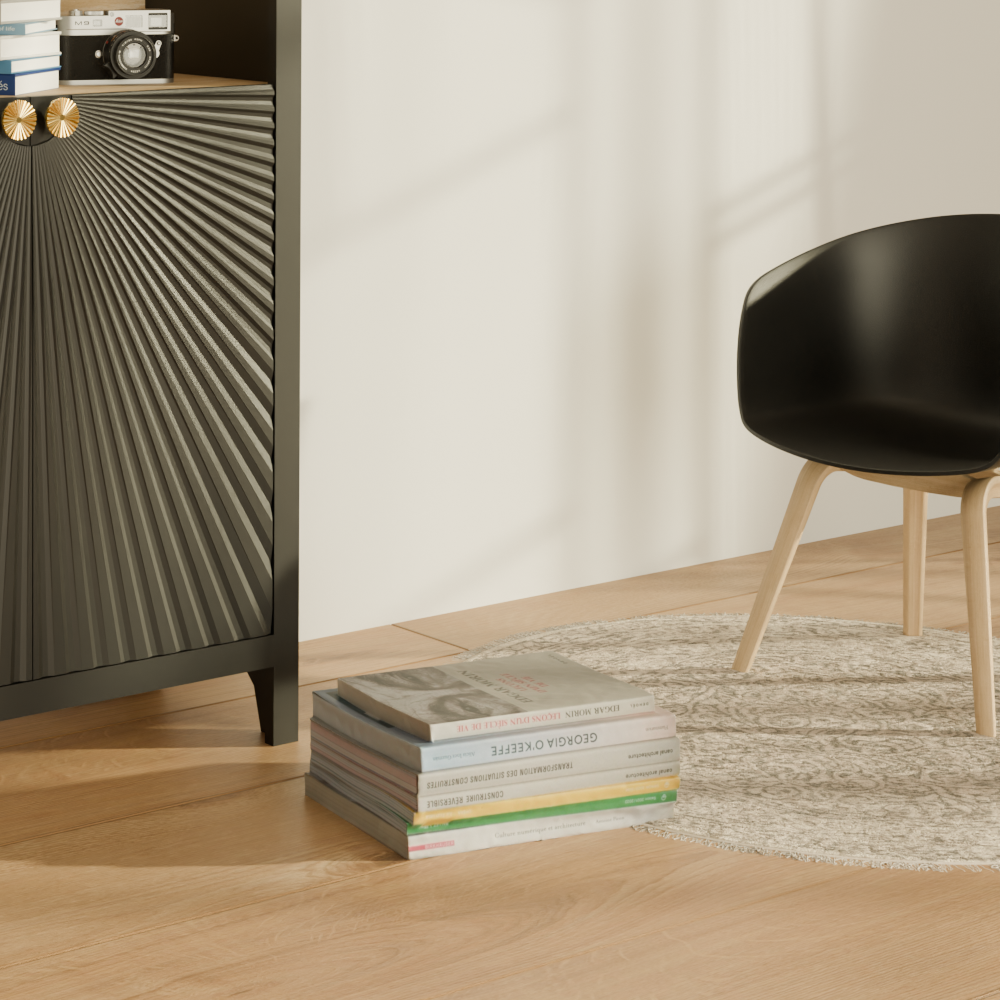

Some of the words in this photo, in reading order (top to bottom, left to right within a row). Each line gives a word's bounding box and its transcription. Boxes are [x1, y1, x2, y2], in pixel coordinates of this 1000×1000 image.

[564, 707, 592, 718] MORIN
[592, 704, 621, 715] EDGAR
[509, 715, 530, 726] D'UN
[531, 711, 561, 723] LEÇONS
[456, 724, 469, 733] VIE
[470, 722, 482, 731] DE
[483, 719, 508, 730] SIÈCLE
[547, 732, 598, 749] GEORGIA
[491, 739, 545, 757] O'KEEFFE
[659, 748, 674, 756] canal
[627, 750, 659, 759] architecture
[506, 769, 518, 778] DES
[519, 761, 573, 776] TRANSFORMATION
[625, 769, 658, 779] architecture
[426, 776, 469, 789] CONSTRUITES
[470, 771, 505, 783] SITUATIONS
[466, 790, 504, 803] CONSTRUIRE
[427, 796, 464, 809] RÉVERSIBLE
[494, 830, 516, 839] Culture
[517, 826, 547, 835] numérique
[554, 821, 586, 829] architecture
